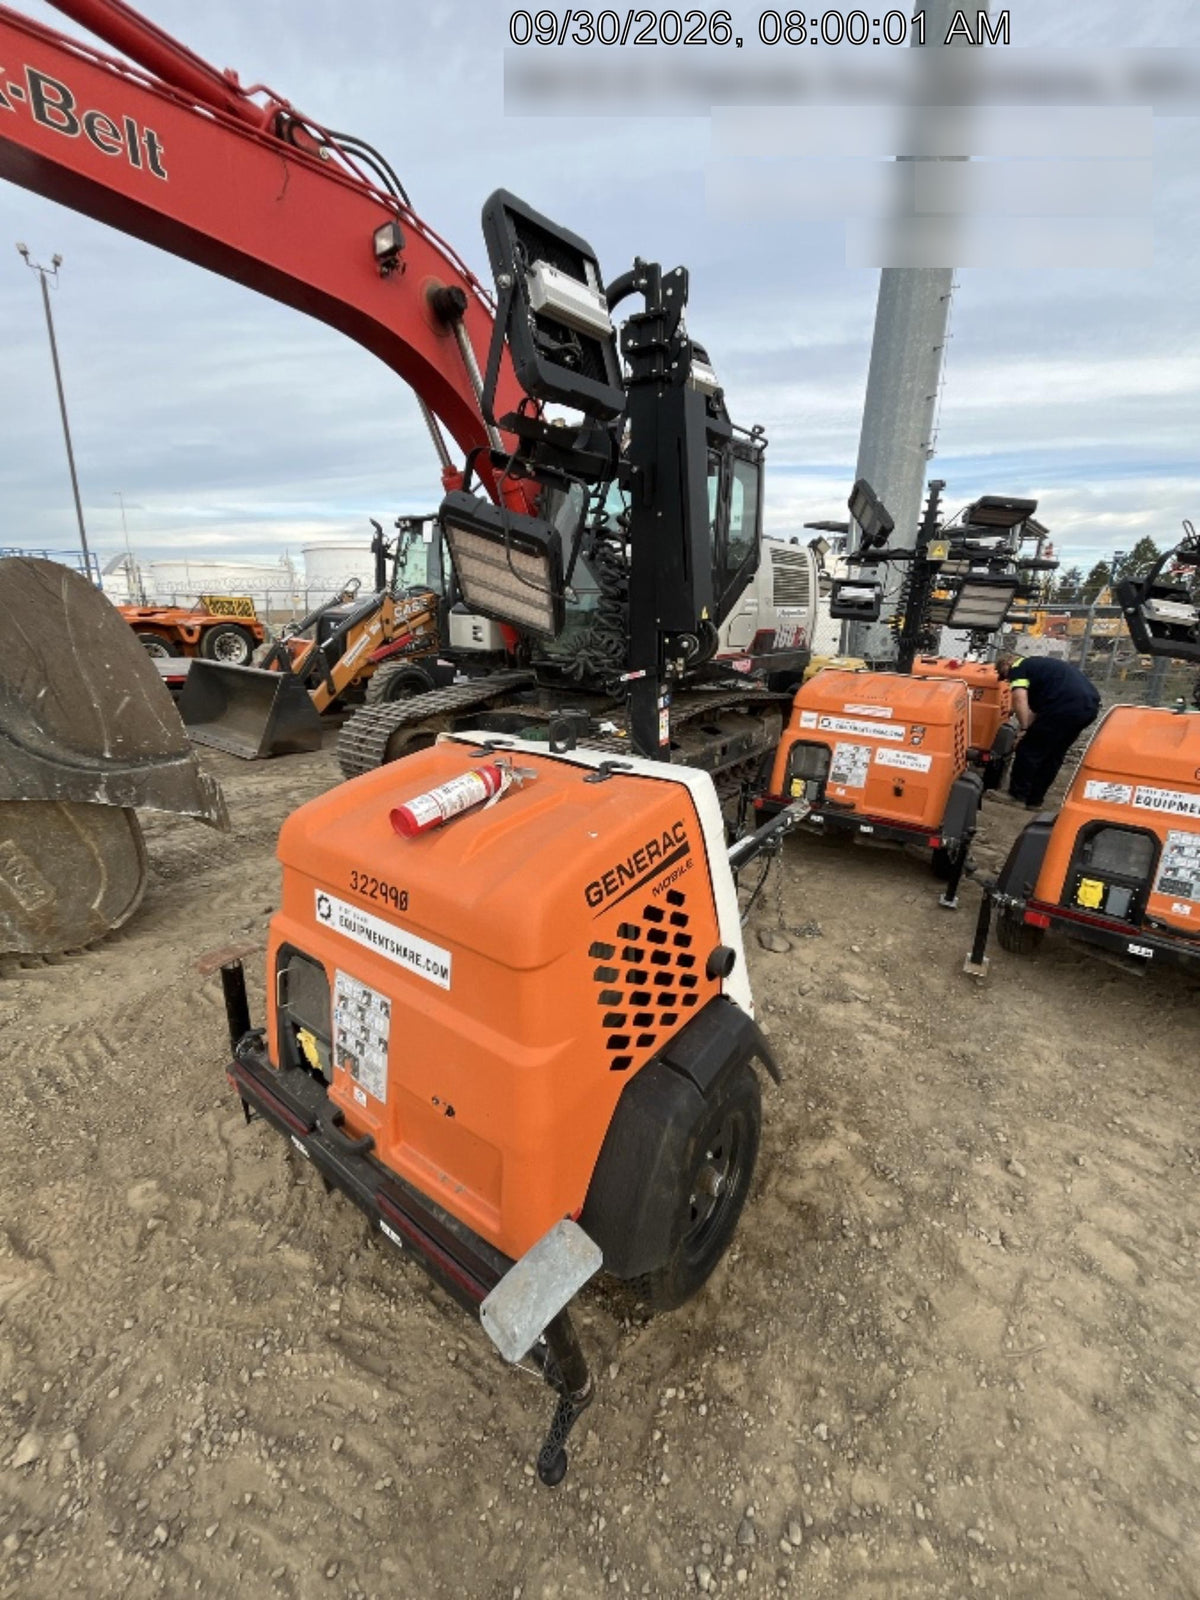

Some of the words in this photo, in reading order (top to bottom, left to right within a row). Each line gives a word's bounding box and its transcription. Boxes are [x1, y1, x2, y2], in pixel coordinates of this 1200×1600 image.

[1135, 794, 1200, 815] EQUIPME
[584, 820, 687, 908] GENERAC
[651, 858, 694, 898] MOBILE
[338, 915, 449, 980] EQUIPMENTSHARE.COM
